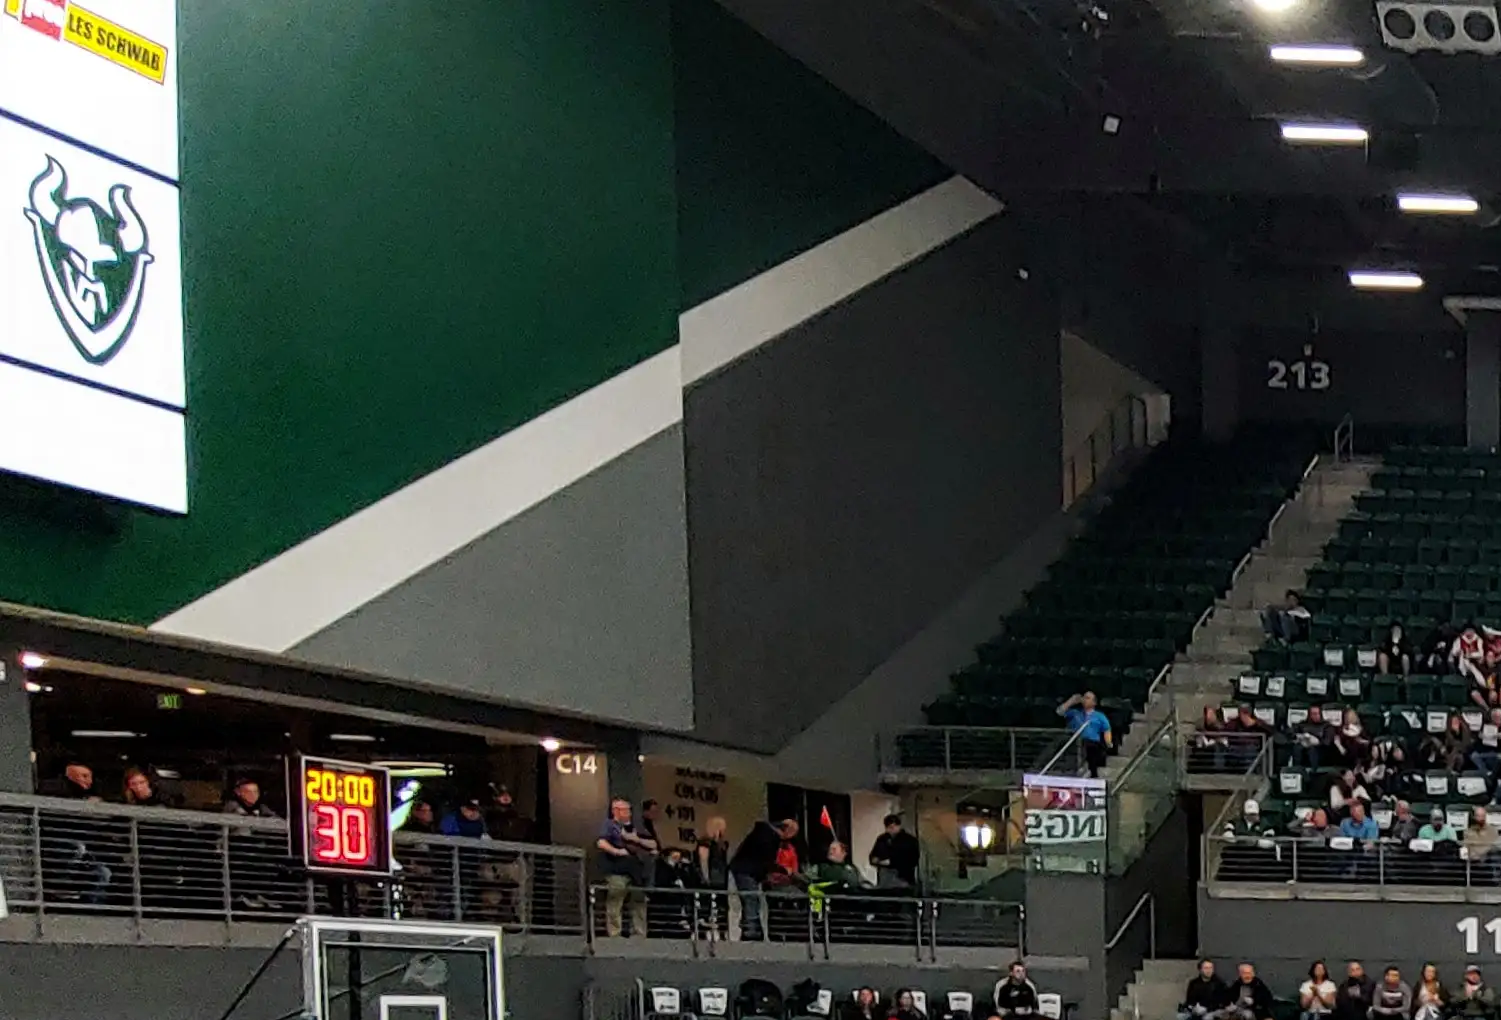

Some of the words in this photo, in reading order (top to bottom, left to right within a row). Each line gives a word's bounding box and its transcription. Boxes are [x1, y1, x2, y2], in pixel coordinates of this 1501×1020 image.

[68, 13, 93, 40] LES
[96, 27, 160, 71] SCHWAB
[1267, 360, 1330, 390] 213
[555, 754, 598, 775] C14
[306, 769, 375, 807] 20:00
[316, 804, 368, 862] 30
